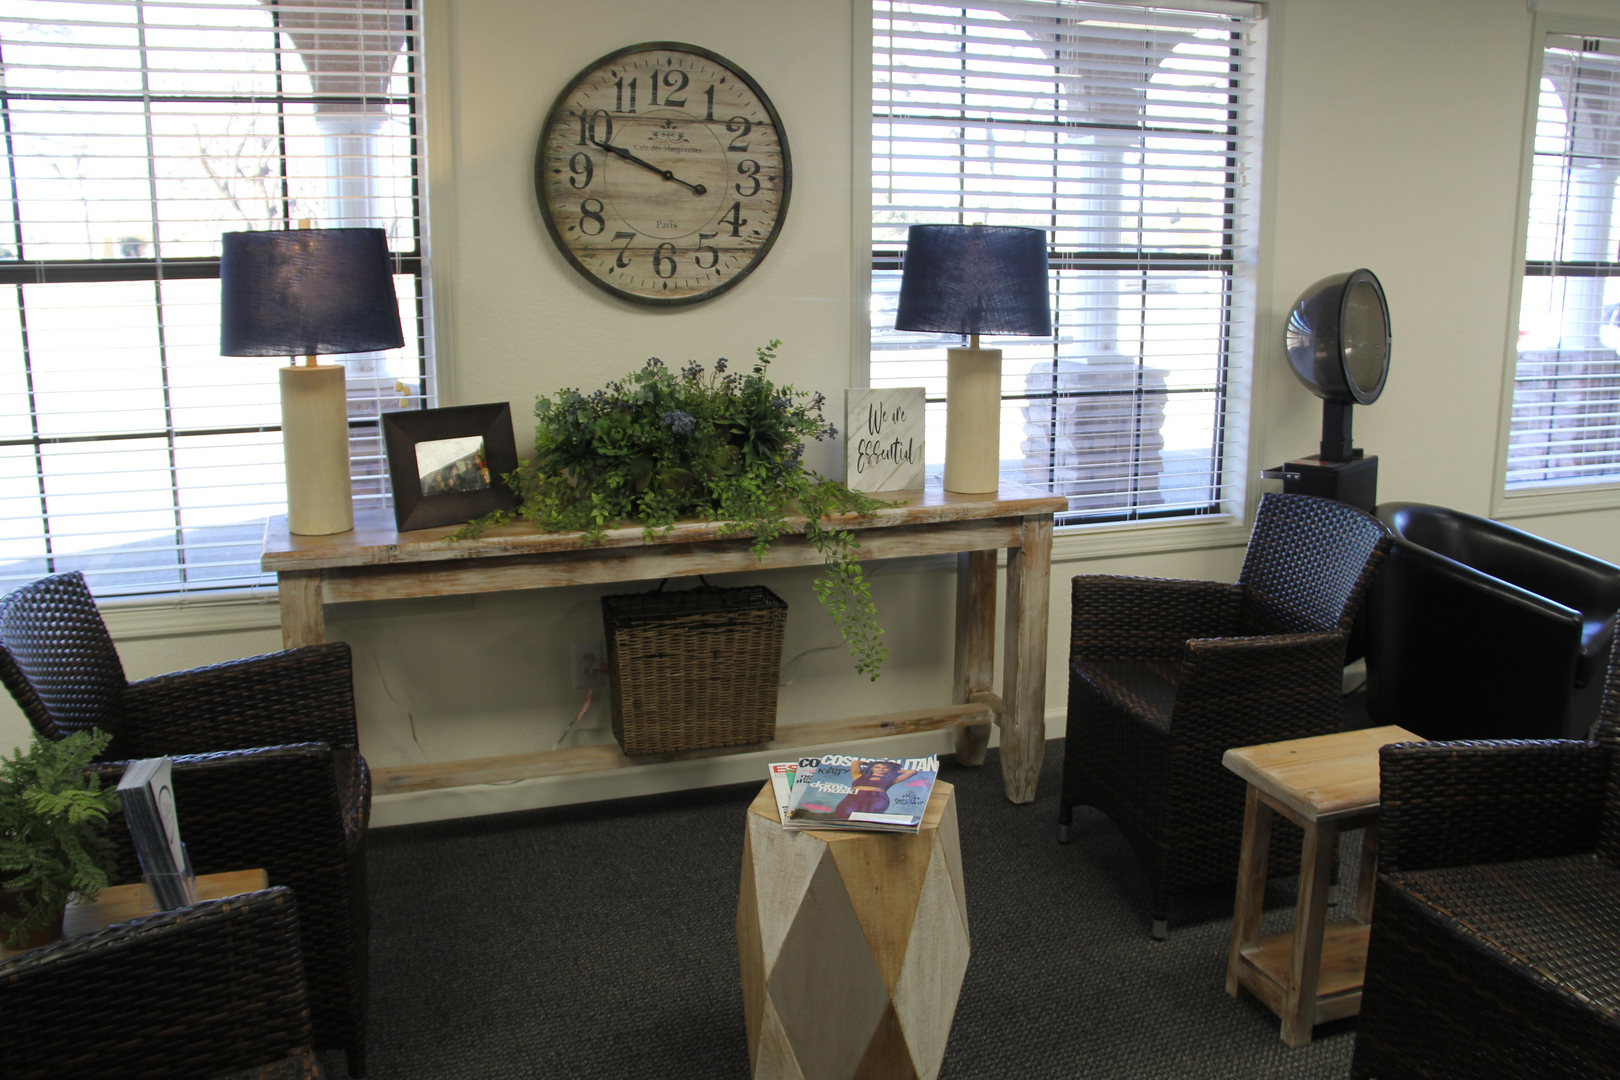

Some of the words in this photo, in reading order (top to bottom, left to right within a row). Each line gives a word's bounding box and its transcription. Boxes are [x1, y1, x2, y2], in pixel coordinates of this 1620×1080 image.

[613, 75, 637, 114] 11
[648, 68, 689, 108] 12
[703, 83, 717, 121] 1
[574, 108, 613, 146] 10
[725, 115, 752, 153] 2
[569, 152, 594, 190] 9
[735, 159, 761, 197] 3
[578, 198, 606, 236] 8
[656, 220, 678, 229] Paris
[717, 201, 748, 238] 4
[610, 231, 637, 269] 7
[652, 242, 677, 279] 6
[694, 231, 719, 269] 5
[869, 402, 888, 435] We
[892, 406, 907, 424] are
[857, 437, 915, 473] Essential
[817, 768, 841, 776] King
[821, 754, 937, 772] COSMLITAN
[828, 766, 850, 774] Joey
[809, 780, 848, 791] damn
[818, 786, 860, 795] mask!
